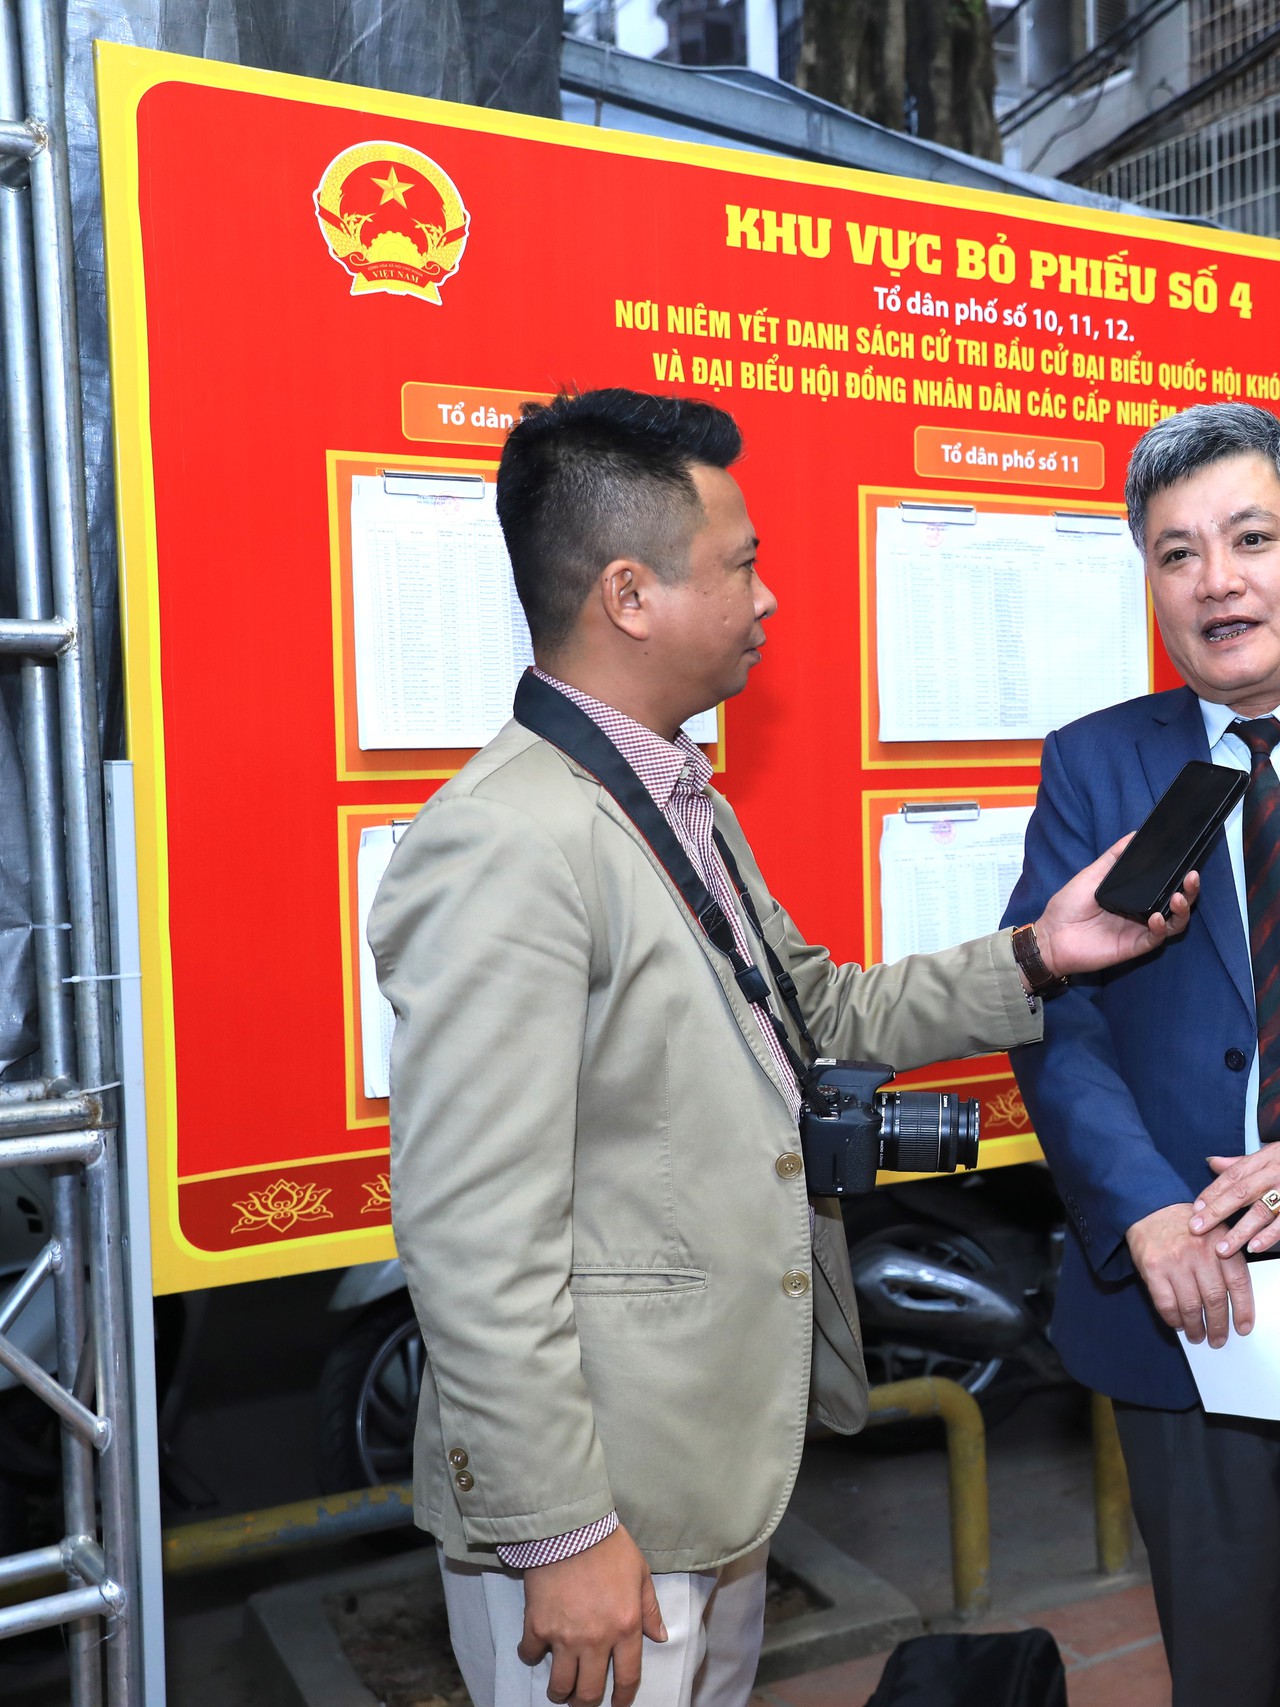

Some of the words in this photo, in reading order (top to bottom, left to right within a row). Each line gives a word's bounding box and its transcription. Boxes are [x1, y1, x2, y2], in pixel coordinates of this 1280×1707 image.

[372, 270, 395, 279] VIỆT
[397, 270, 419, 283] NAM
[725, 204, 832, 259] KHU
[846, 221, 942, 277] VỰC
[956, 232, 1016, 285] BỎ
[1030, 250, 1157, 305] PHIẾU
[1168, 264, 1218, 314] SỐ
[1229, 281, 1253, 319] 4
[873, 284, 901, 312] Tổ
[906, 290, 949, 318] dân
[955, 297, 999, 326] phố
[1003, 302, 1027, 328] số
[1032, 308, 1064, 336] 10,
[1069, 313, 1100, 341] 11,
[1105, 318, 1135, 342] 12.
[615, 299, 659, 331] NƠI
[667, 302, 731, 339] NIÊM
[738, 307, 780, 345] YẾT
[787, 319, 849, 352] DANH
[856, 324, 915, 359] SÁCH
[921, 328, 952, 363] CỬ
[955, 339, 988, 367] TRI
[994, 336, 1035, 373] BẦU
[1041, 343, 1069, 377] CỬ
[1072, 353, 1105, 385] ĐẠI
[1110, 350, 1153, 386] BIỂU
[1158, 358, 1207, 392] QUỐC
[1212, 366, 1241, 401] HỘI
[652, 348, 685, 383] VÀ
[692, 356, 733, 393] ĐẠI
[740, 353, 794, 393] BIỂU
[801, 363, 839, 402] HỘI
[845, 365, 907, 404] ĐỒNG
[913, 377, 972, 410] NHÂN
[979, 382, 1021, 415] DÂN
[1027, 387, 1067, 420] CÁC
[1072, 389, 1111, 423] CẤP
[437, 401, 466, 426] Tổ
[470, 406, 514, 429] dân
[941, 442, 962, 463] Tổ
[966, 446, 998, 466] dân
[1002, 449, 1036, 472] phố
[1038, 452, 1058, 472] số
[1061, 455, 1080, 473] 11
